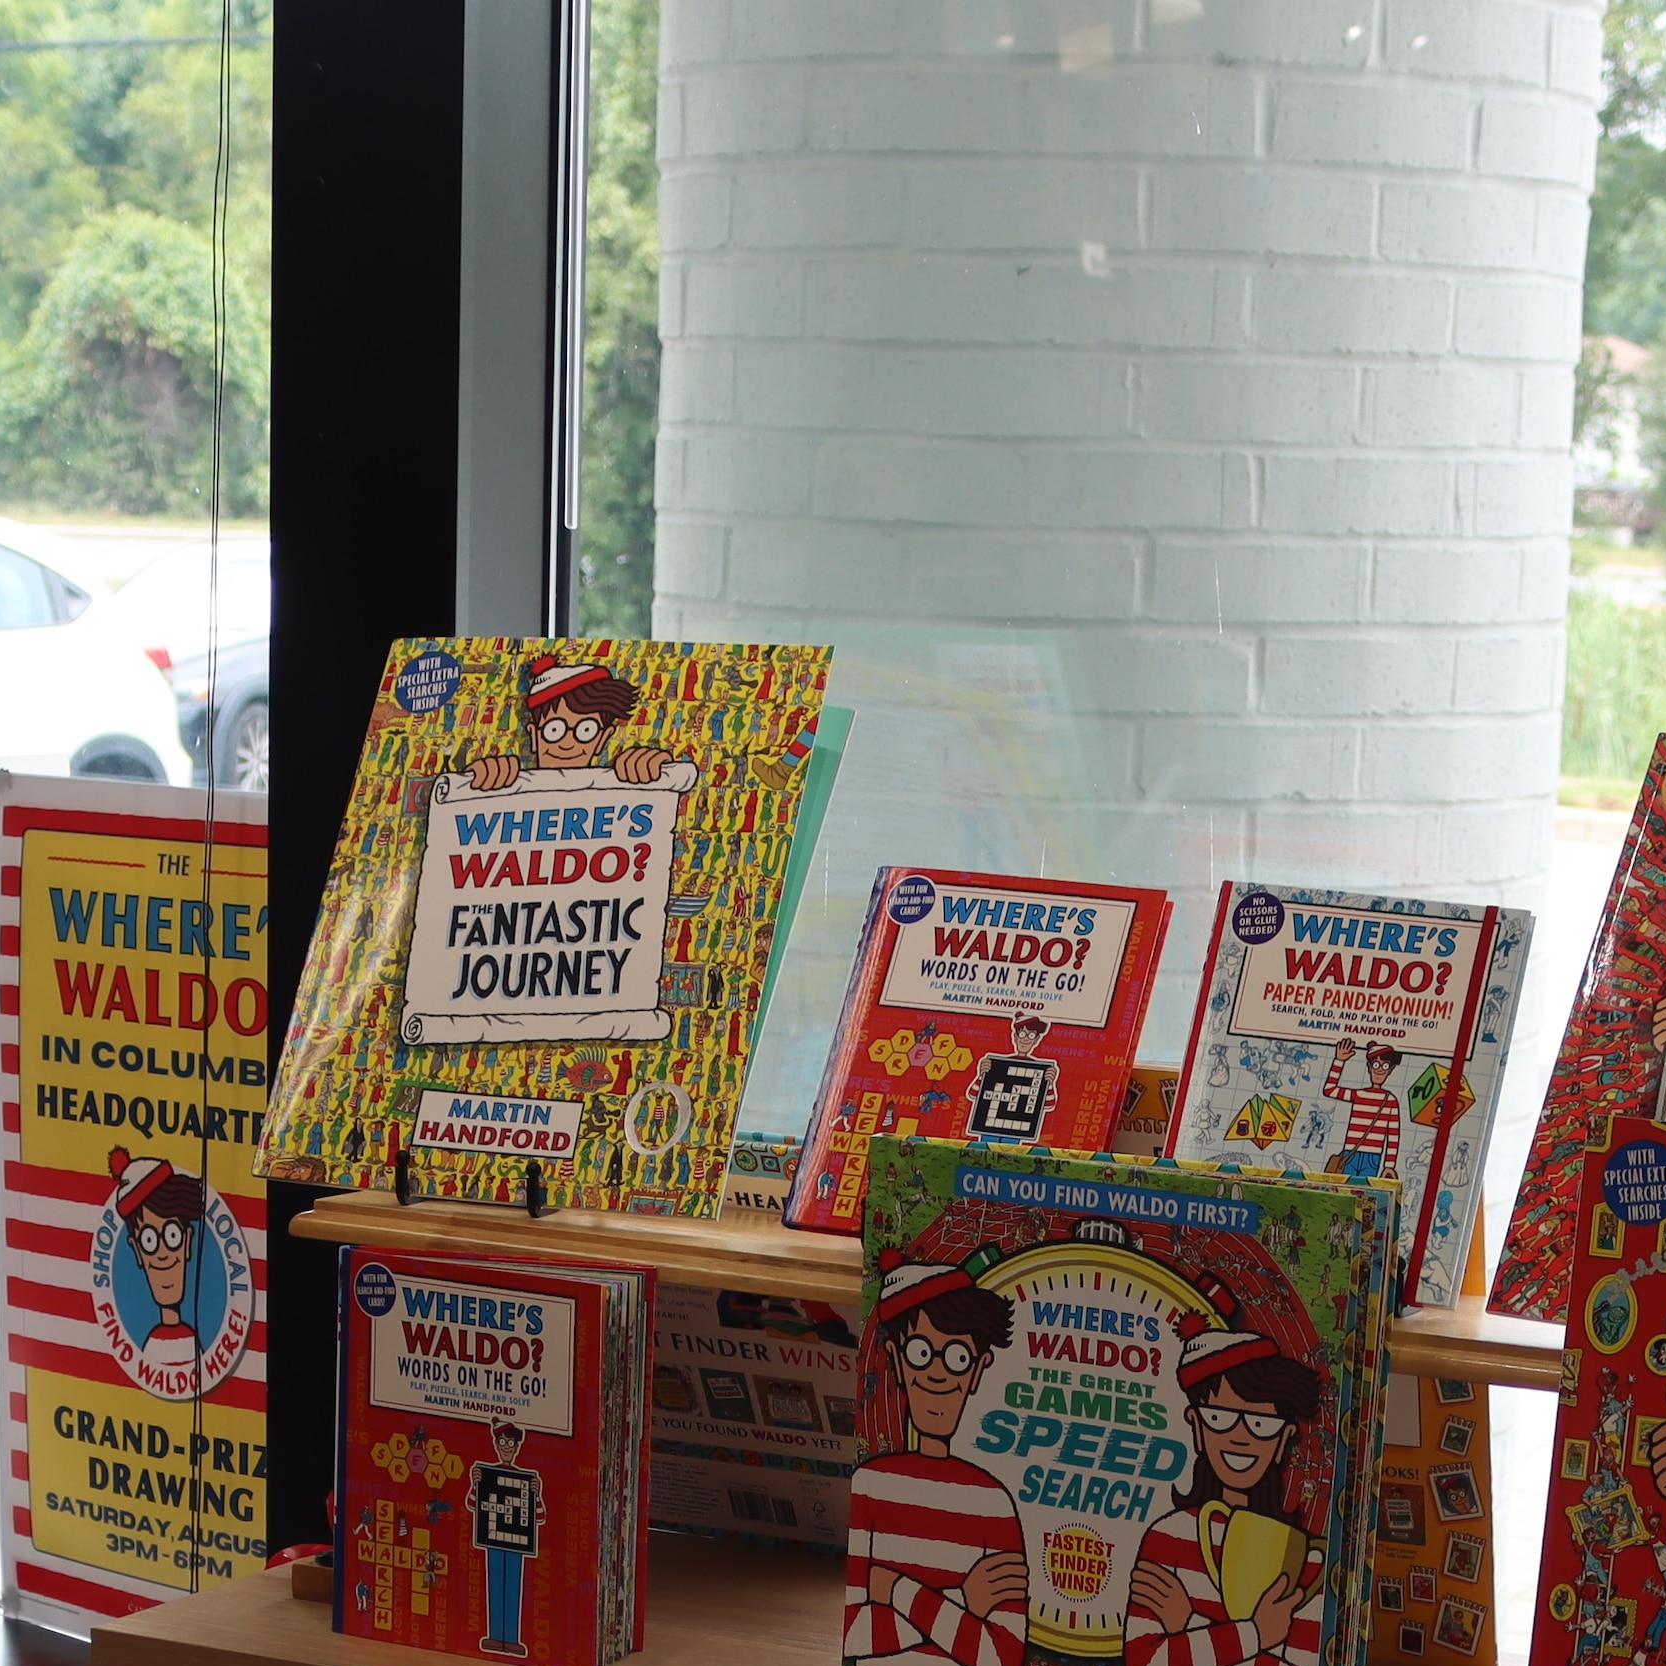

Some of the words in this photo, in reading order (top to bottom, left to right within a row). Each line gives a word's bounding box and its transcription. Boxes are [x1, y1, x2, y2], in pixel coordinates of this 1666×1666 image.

[397, 671, 429, 688] SPECIAL
[432, 666, 458, 681] EXTRA
[419, 657, 441, 671] WITH
[407, 681, 447, 699] SEARCHES
[412, 696, 440, 711] INSIDE
[454, 803, 654, 845] WHERE'S
[157, 853, 190, 876] THE
[450, 842, 652, 890] WALDO?
[471, 904, 493, 915] THE
[943, 896, 1097, 935] WHERE'S
[1240, 906, 1277, 916] SCISSORS
[1253, 897, 1265, 906] NO
[446, 897, 644, 948] FANTASTIC
[1239, 917, 1252, 926] OR
[1254, 916, 1276, 925] GLUE
[1239, 926, 1276, 936] NEEDED!
[1293, 914, 1458, 957] WHERE'S
[934, 927, 1091, 970] WALDO?
[452, 949, 630, 1001] JOURNEY
[921, 959, 978, 982] WORDS
[986, 966, 1009, 986] ON
[1017, 968, 1048, 988] THE
[1056, 974, 1086, 992] GO!
[1285, 948, 1452, 995] WALDO?
[53, 958, 269, 1037] WALDO
[930, 982, 950, 991] PLAY,
[952, 983, 984, 994] PUZZLE,
[986, 987, 1017, 997] SEARCH,
[1040, 992, 1064, 1001] SOLVE
[943, 993, 982, 1004] MARTIN
[985, 998, 1044, 1011] HANDFORD
[1264, 982, 1315, 1005] PAPER
[1322, 989, 1454, 1020] PANDEMONIUM!
[1271, 1004, 1307, 1016] SEARCH,
[1311, 1009, 1335, 1019] FOLD,
[1339, 1012, 1357, 1021] AND
[1361, 1014, 1382, 1024] PLAY
[1386, 1017, 1398, 1025] ON
[1403, 1018, 1419, 1028] THE
[1422, 1020, 1438, 1029] GO!
[1298, 1019, 1341, 1031] MARTIN
[1344, 1024, 1406, 1038] HANDFORD
[42, 1034, 80, 1065] IN
[91, 1040, 266, 1087] COLUMB
[447, 1098, 552, 1125] MARTIN
[419, 1120, 571, 1152] HANDFORD
[1627, 1148, 1655, 1166] WITH
[1604, 1168, 1644, 1186] SPECIAL
[962, 1172, 1003, 1197] CAN
[1008, 1177, 1047, 1201] YOU
[1054, 1183, 1100, 1209] FIND
[1108, 1190, 1179, 1220] WALDO
[1186, 1201, 1249, 1228] FIRST?
[1628, 1203, 1661, 1221] INSIDE
[93, 1208, 118, 1288] SHOP
[206, 1198, 249, 1297] LOCAL
[402, 1287, 543, 1335] WHERE'S
[1033, 1301, 1160, 1342] WHERE'S
[97, 1301, 134, 1365] FIND
[138, 1359, 200, 1396] WALDO
[206, 1308, 248, 1383] HERE!
[402, 1320, 544, 1373] WALDO?
[671, 1333, 771, 1362] FINDER
[1027, 1332, 1161, 1376] WALDO?
[398, 1356, 449, 1383] WORDS
[457, 1366, 477, 1387] ON
[485, 1370, 512, 1393] THE
[520, 1376, 546, 1398] GO!
[1029, 1367, 1072, 1385] THE
[1080, 1374, 1156, 1399] GREAT
[1004, 1381, 1168, 1431] GAMES
[662, 1417, 692, 1431] YOU
[696, 1422, 747, 1438] FOUND
[751, 1429, 807, 1446] WALDO
[812, 1437, 841, 1450] YET?
[975, 1410, 1189, 1483] SPEED
[88, 1456, 254, 1523] DRAWING
[1018, 1464, 1155, 1523] SEARCH
[1042, 1531, 1115, 1560] FASTEST
[1050, 1553, 1108, 1579] FINDER
[1051, 1571, 1102, 1595] WINS!
